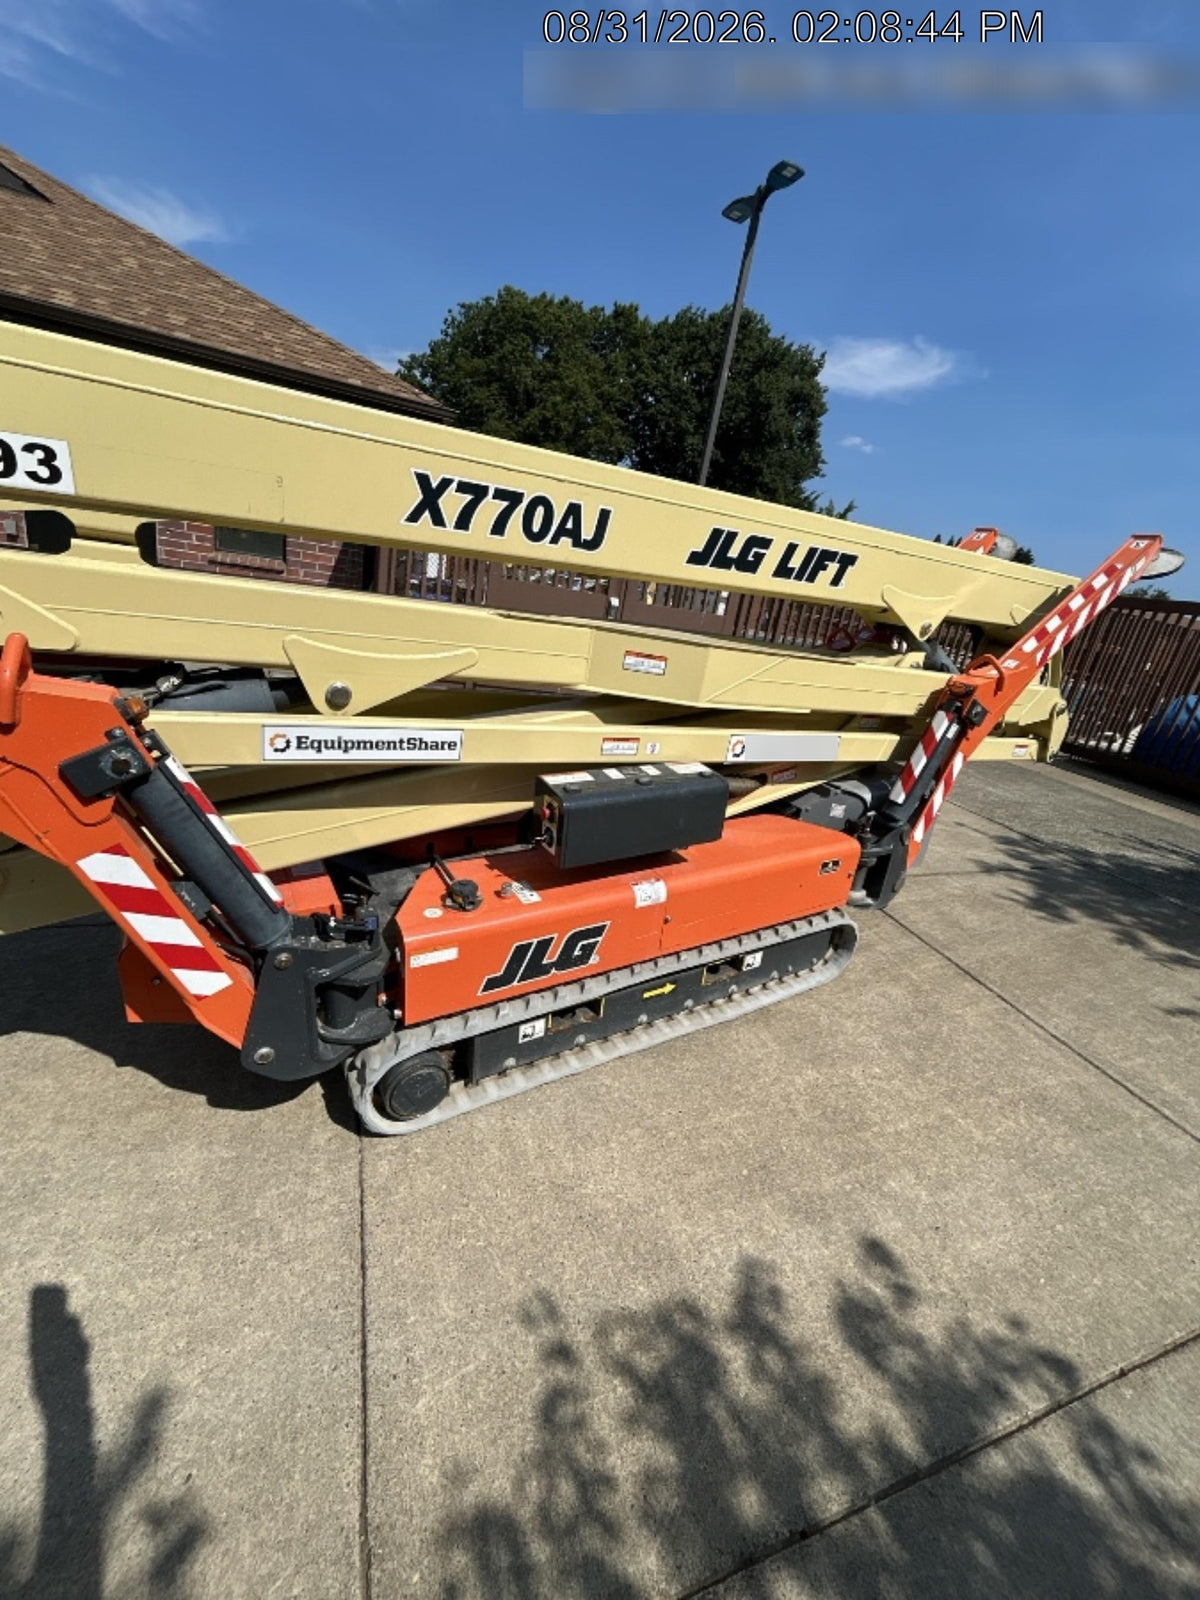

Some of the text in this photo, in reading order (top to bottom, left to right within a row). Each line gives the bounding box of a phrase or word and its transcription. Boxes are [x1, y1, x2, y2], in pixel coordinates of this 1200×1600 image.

[403, 470, 613, 552] X770AJ
[685, 526, 860, 588] JLG LIFT
[295, 735, 458, 754] EquipmentShare
[477, 921, 611, 995] JLG
